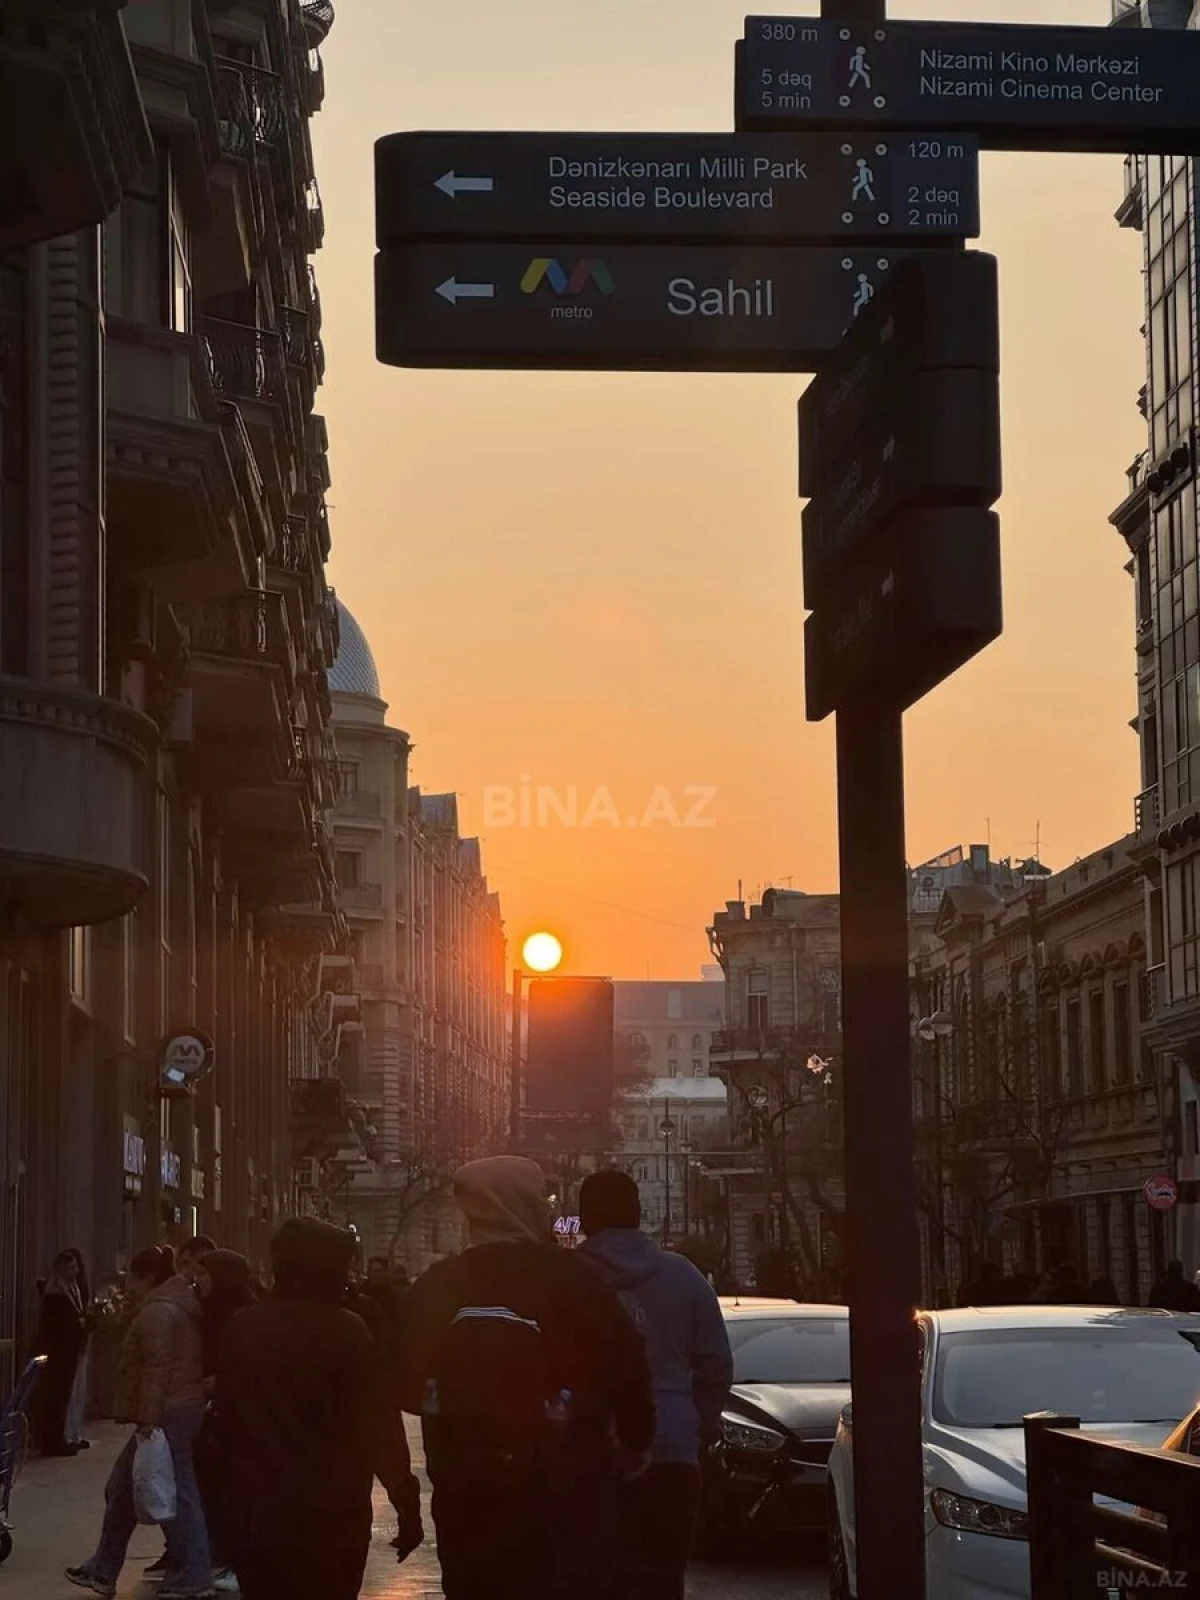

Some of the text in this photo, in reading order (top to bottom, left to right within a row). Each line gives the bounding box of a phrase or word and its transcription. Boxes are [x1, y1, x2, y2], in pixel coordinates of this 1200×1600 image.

[761, 23, 818, 41] 380 m
[919, 49, 1140, 75] Nizami Kino Mərkəzi
[761, 68, 812, 89] 5 dəq
[919, 75, 1163, 102] Nizami Cinema Center
[761, 91, 812, 108] 5 min
[907, 141, 964, 158] 120 m
[549, 156, 808, 180] Dənizkənarı Milli Park
[549, 185, 773, 209] Seaside Boulevard
[907, 186, 960, 207] 2 dəq
[907, 208, 959, 225] 2 min
[667, 277, 773, 316] Sahil
[550, 304, 593, 319] metro
